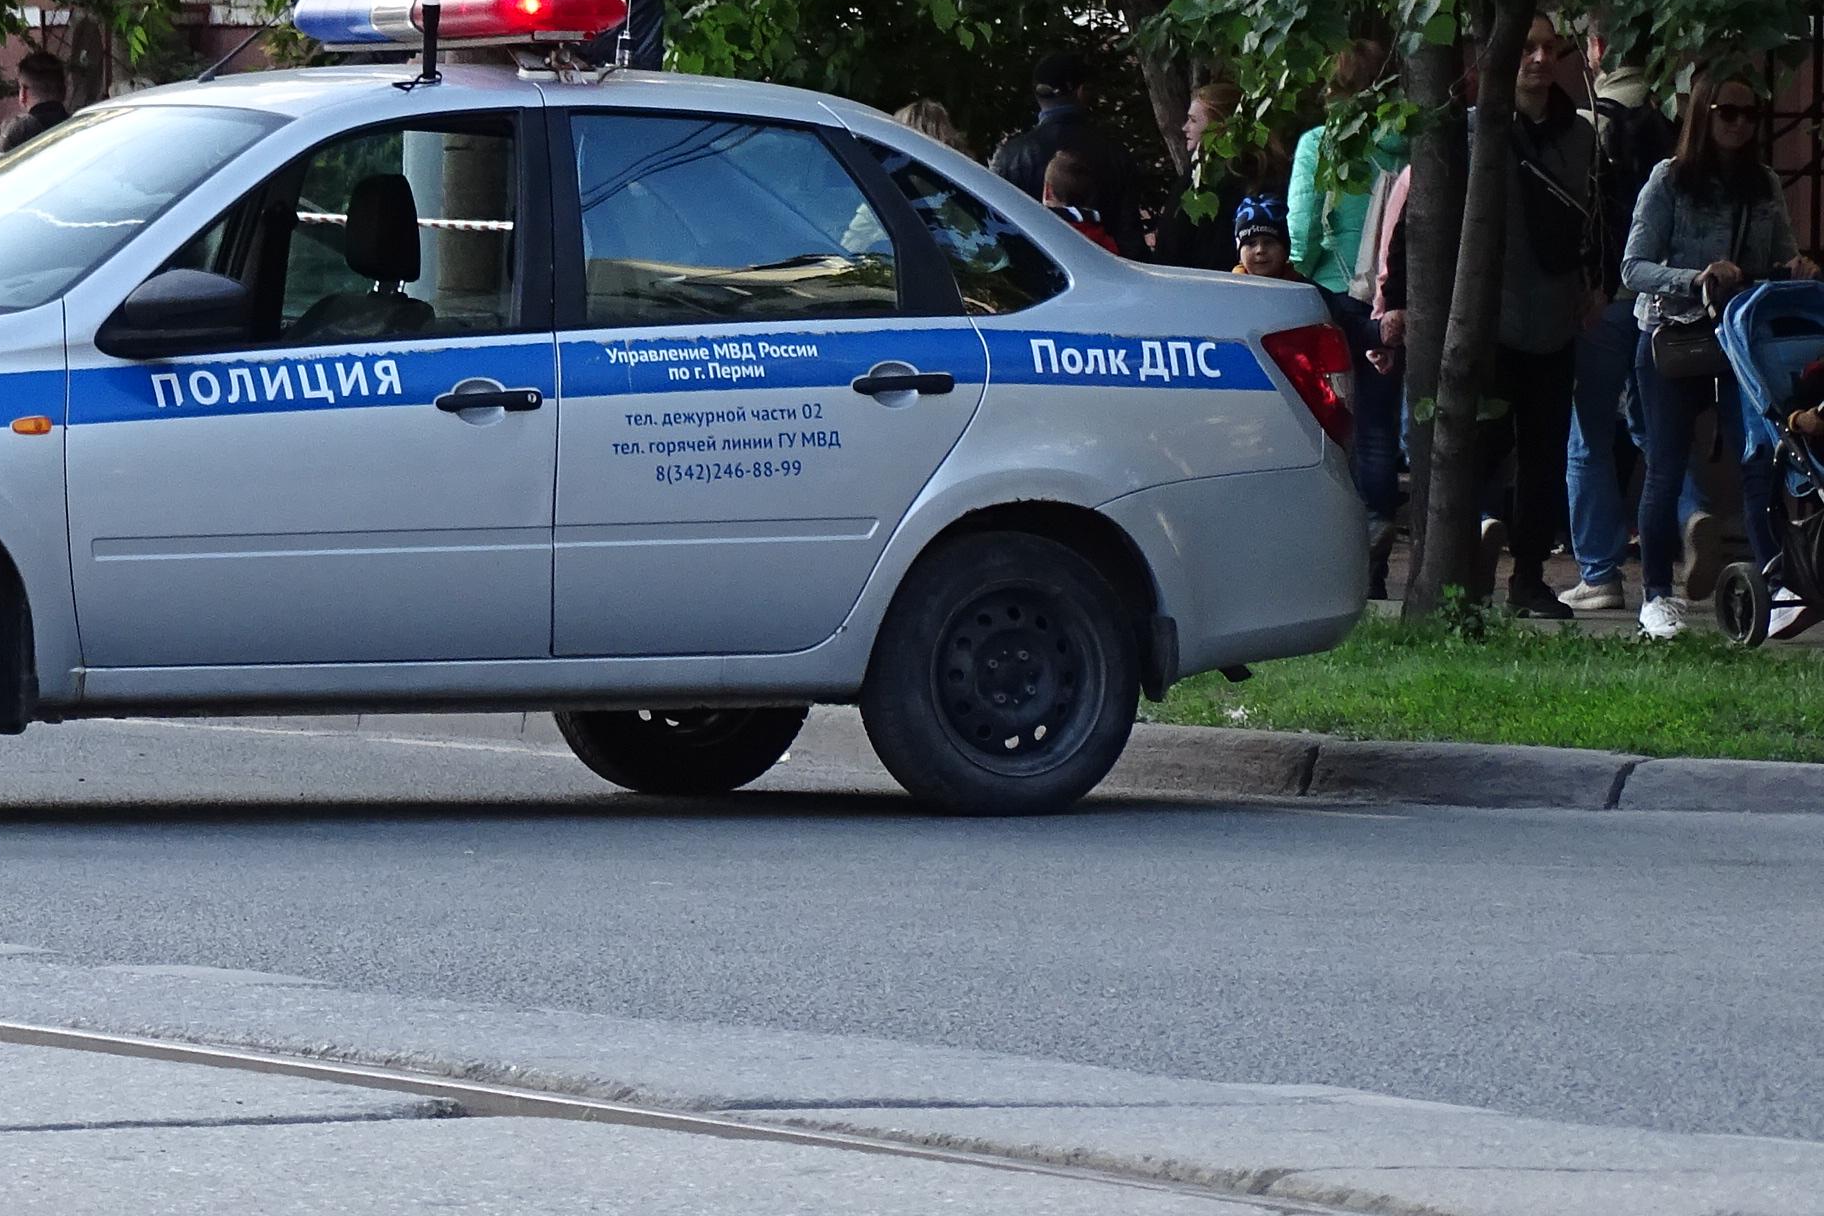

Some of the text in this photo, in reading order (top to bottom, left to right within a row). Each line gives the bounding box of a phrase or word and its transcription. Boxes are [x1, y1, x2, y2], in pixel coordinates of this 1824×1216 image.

[605, 341, 819, 367] Управление МВД России
[1029, 338, 1222, 382] Полк ДПС
[150, 359, 403, 408] ПОЛИЦИЯ
[668, 361, 765, 383] по г. Перми
[625, 403, 823, 427] тел. дежурной части 02
[612, 430, 842, 457] тел. горячей линии ГУ МВД
[655, 459, 803, 485] 8(342)246-88-99
